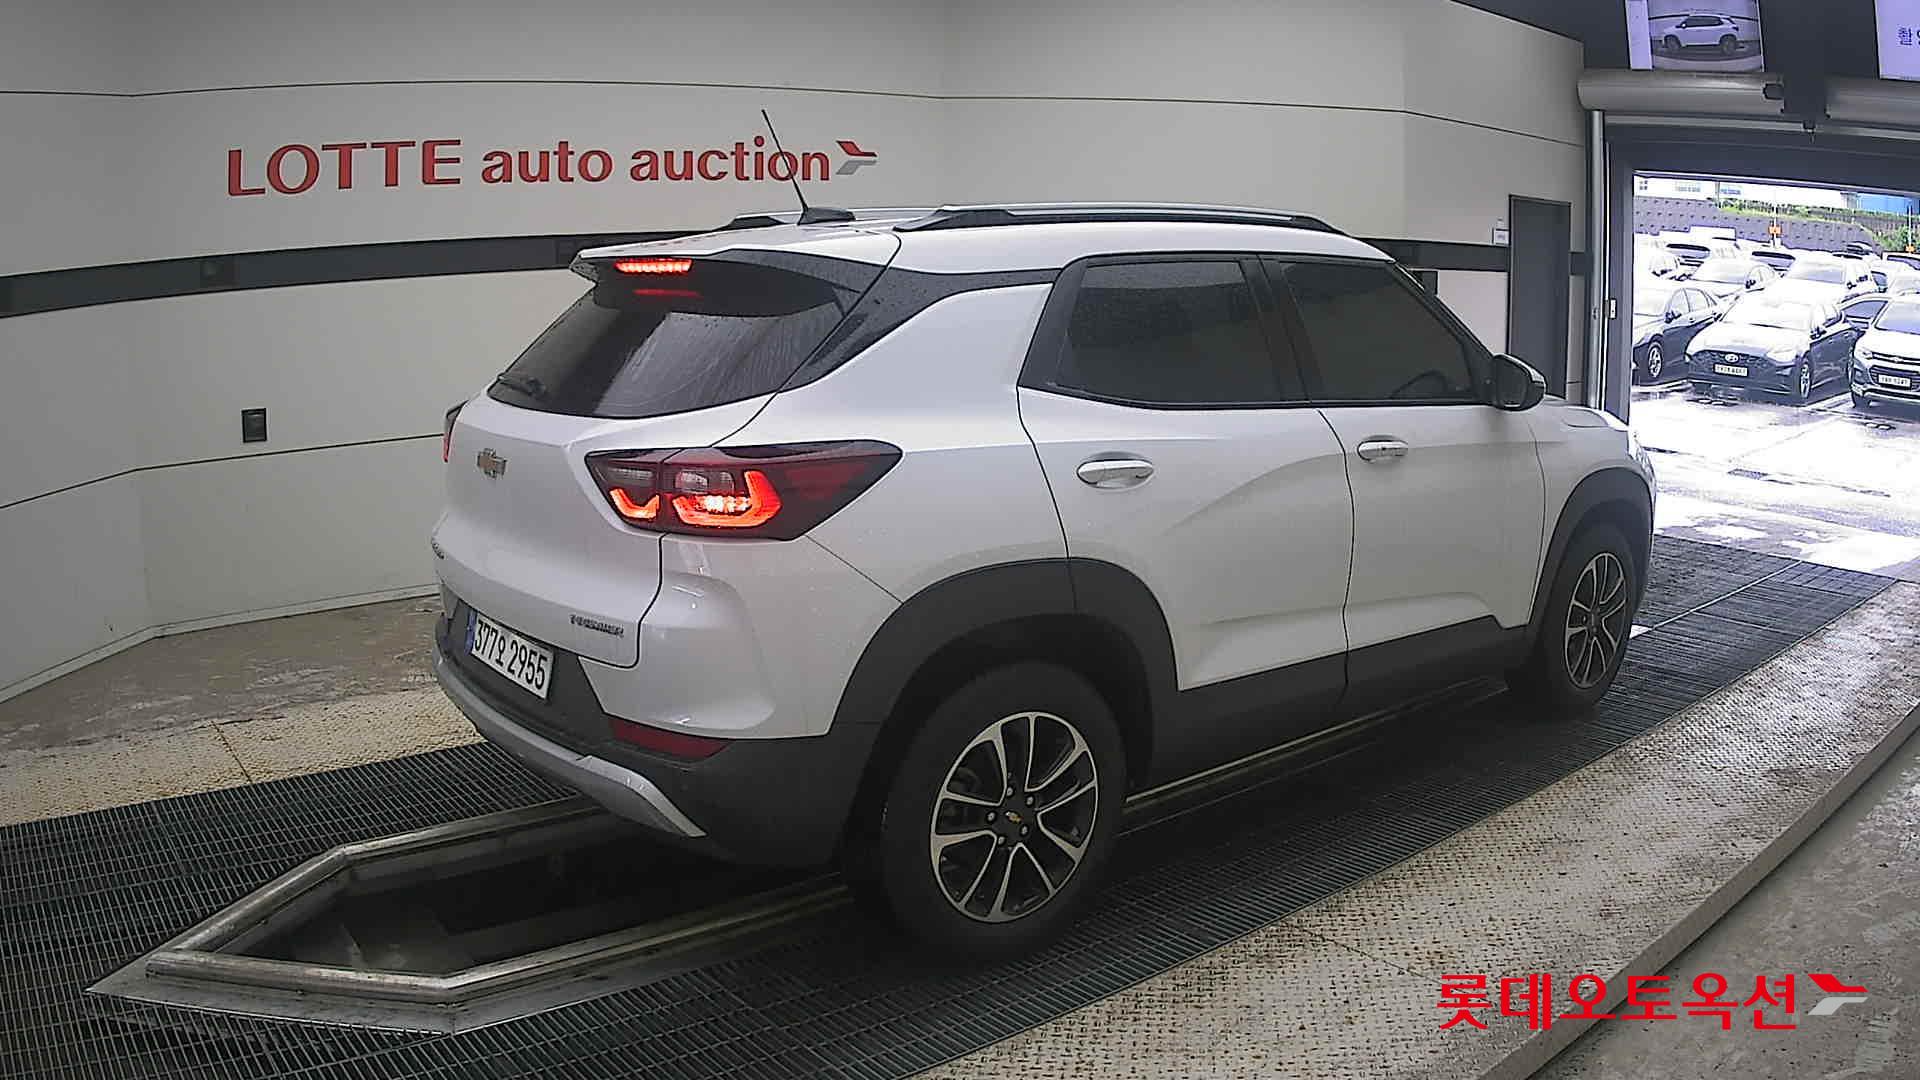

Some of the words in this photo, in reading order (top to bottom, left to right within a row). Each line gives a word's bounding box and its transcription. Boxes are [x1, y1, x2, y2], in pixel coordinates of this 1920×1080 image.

[227, 138, 461, 197] LOTTE
[481, 141, 613, 184] auto
[629, 135, 831, 183] auction
[475, 618, 506, 667] 377오
[507, 639, 548, 690] 2955
